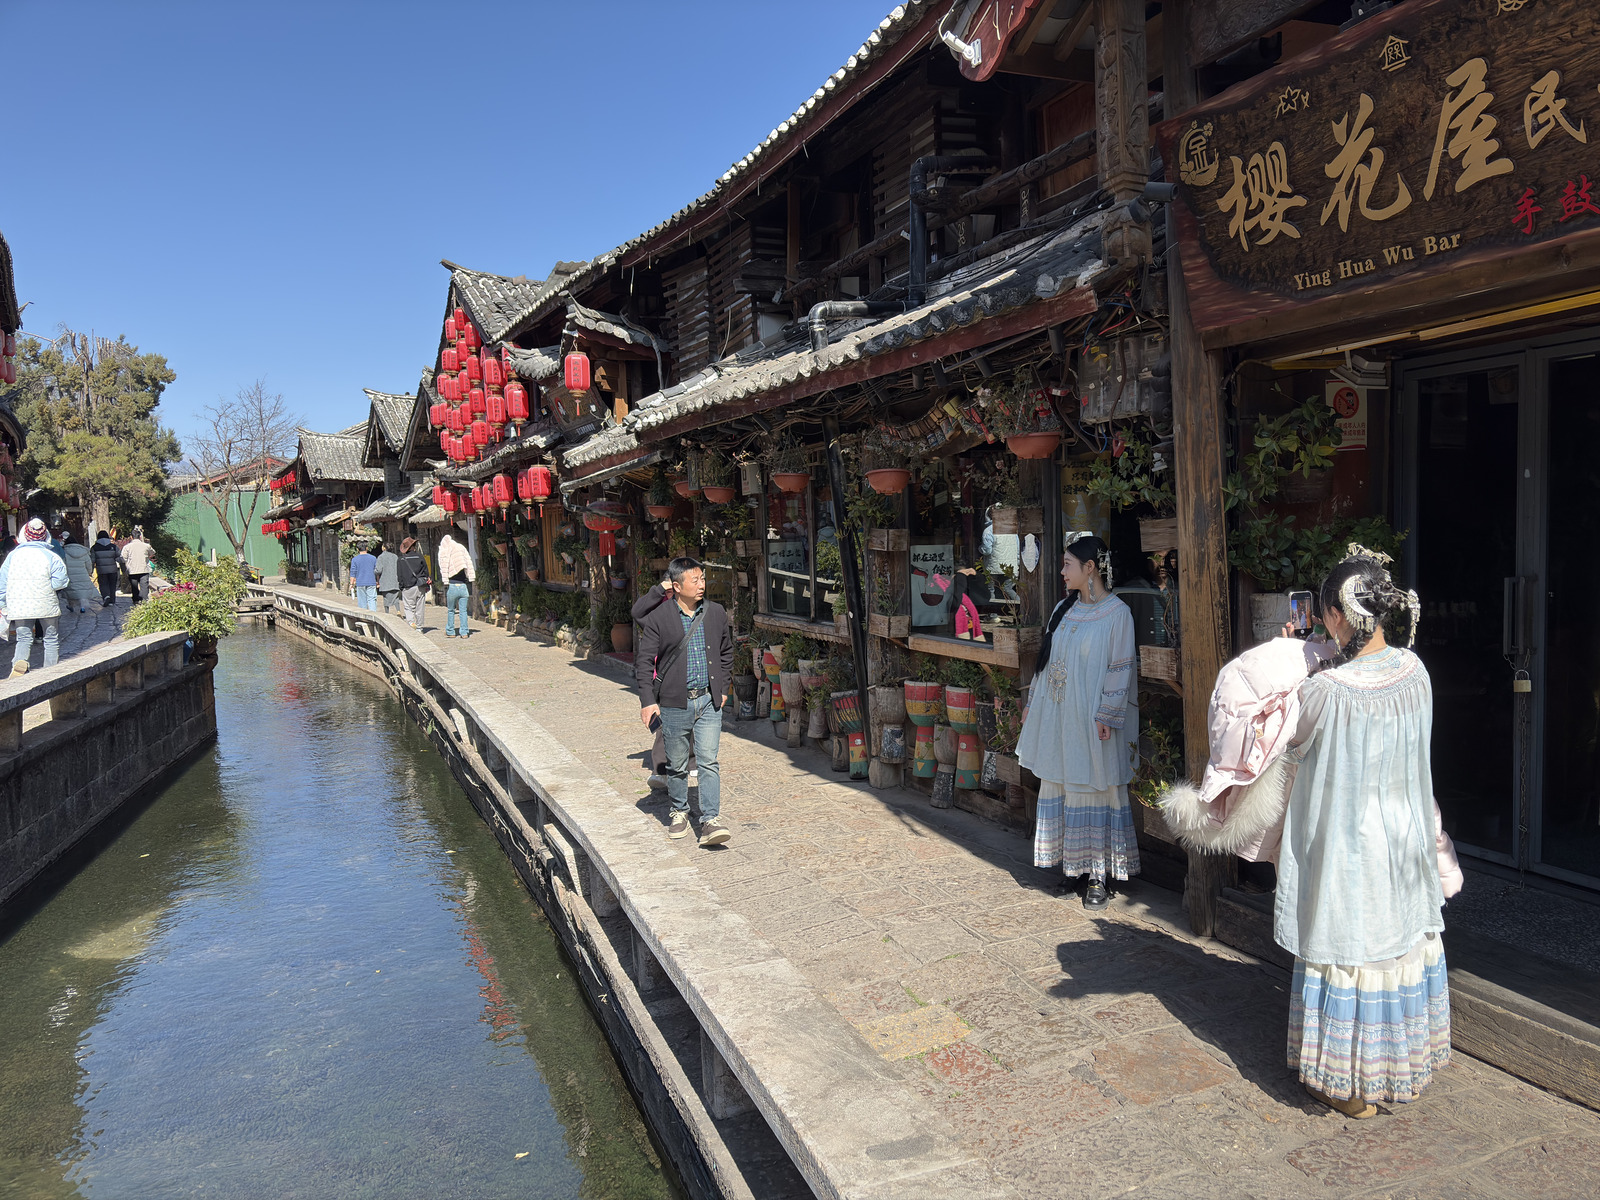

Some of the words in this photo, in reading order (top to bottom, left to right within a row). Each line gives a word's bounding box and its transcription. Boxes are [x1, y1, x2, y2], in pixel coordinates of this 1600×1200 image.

[1217, 57, 1600, 252] 樱花屋民
[1511, 174, 1600, 234] 手鼓
[1293, 269, 1332, 291] Ying
[1338, 257, 1376, 280] Hua
[1382, 245, 1415, 265] Wu
[1423, 232, 1461, 256] Bar
[912, 551, 945, 562] 都在酒里
